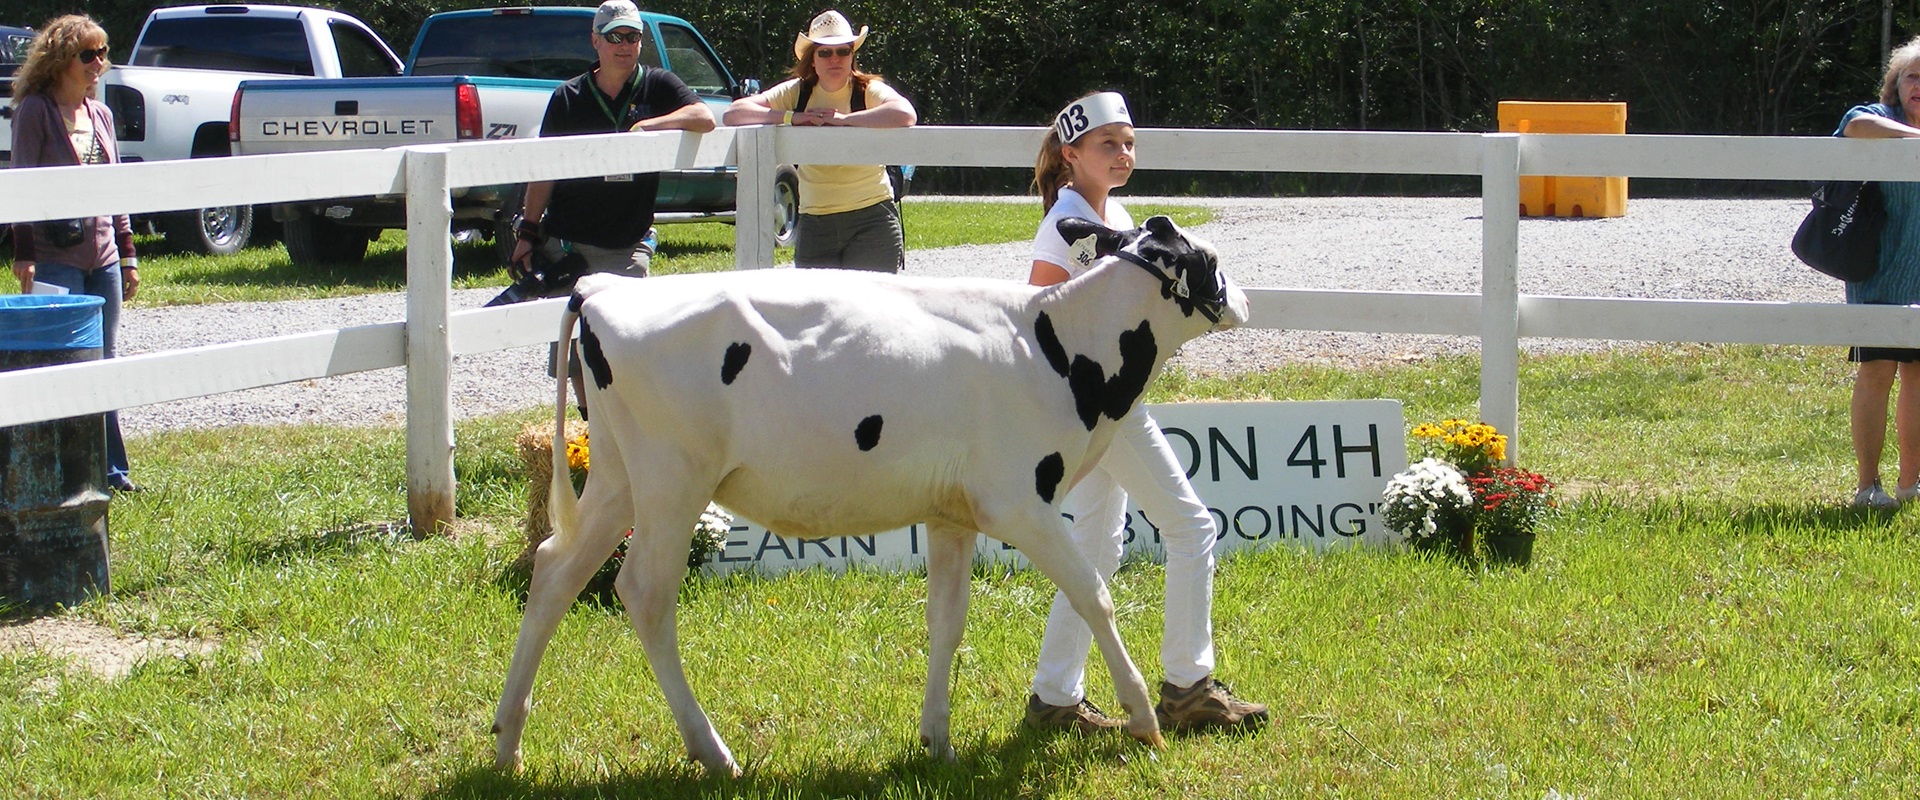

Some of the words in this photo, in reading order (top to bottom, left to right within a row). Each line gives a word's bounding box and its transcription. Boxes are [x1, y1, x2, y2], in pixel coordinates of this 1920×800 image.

[262, 120, 434, 136] CHEVROLET
[486, 123, 518, 140] Z71
[1077, 251, 1093, 266] 306
[1286, 423, 1382, 478] 4H
[703, 524, 876, 563] EARN
